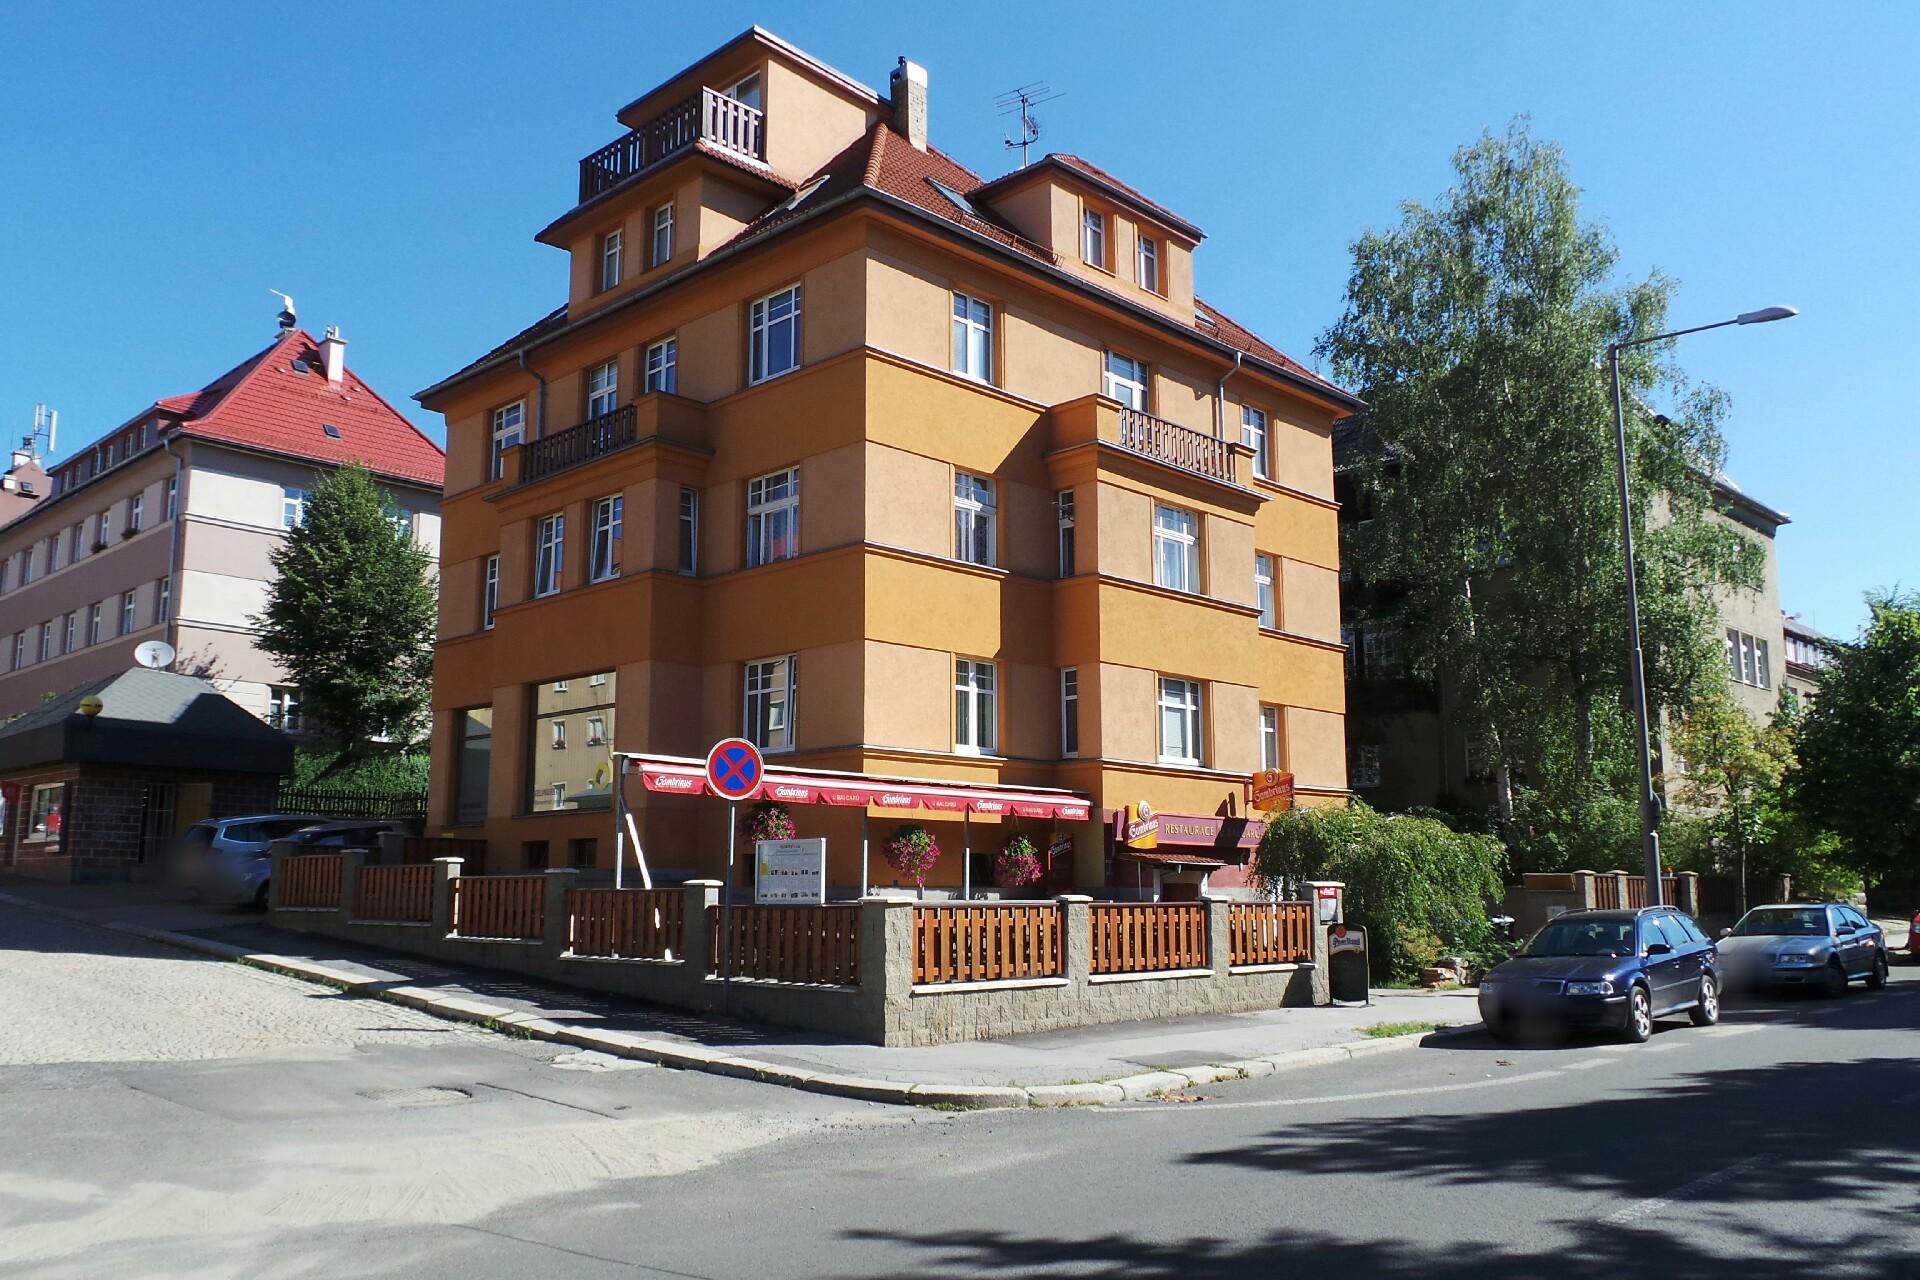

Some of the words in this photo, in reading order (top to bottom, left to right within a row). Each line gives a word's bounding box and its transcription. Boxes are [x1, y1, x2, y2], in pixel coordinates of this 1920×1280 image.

[655, 776, 692, 788] Gambrinus
[775, 786, 808, 797] Gambrinus
[882, 794, 911, 804] Gambrinus
[977, 800, 1003, 811] Gambrinus
[1129, 819, 1159, 838] Gambrinus
[1165, 823, 1214, 836] RESTAURACE
